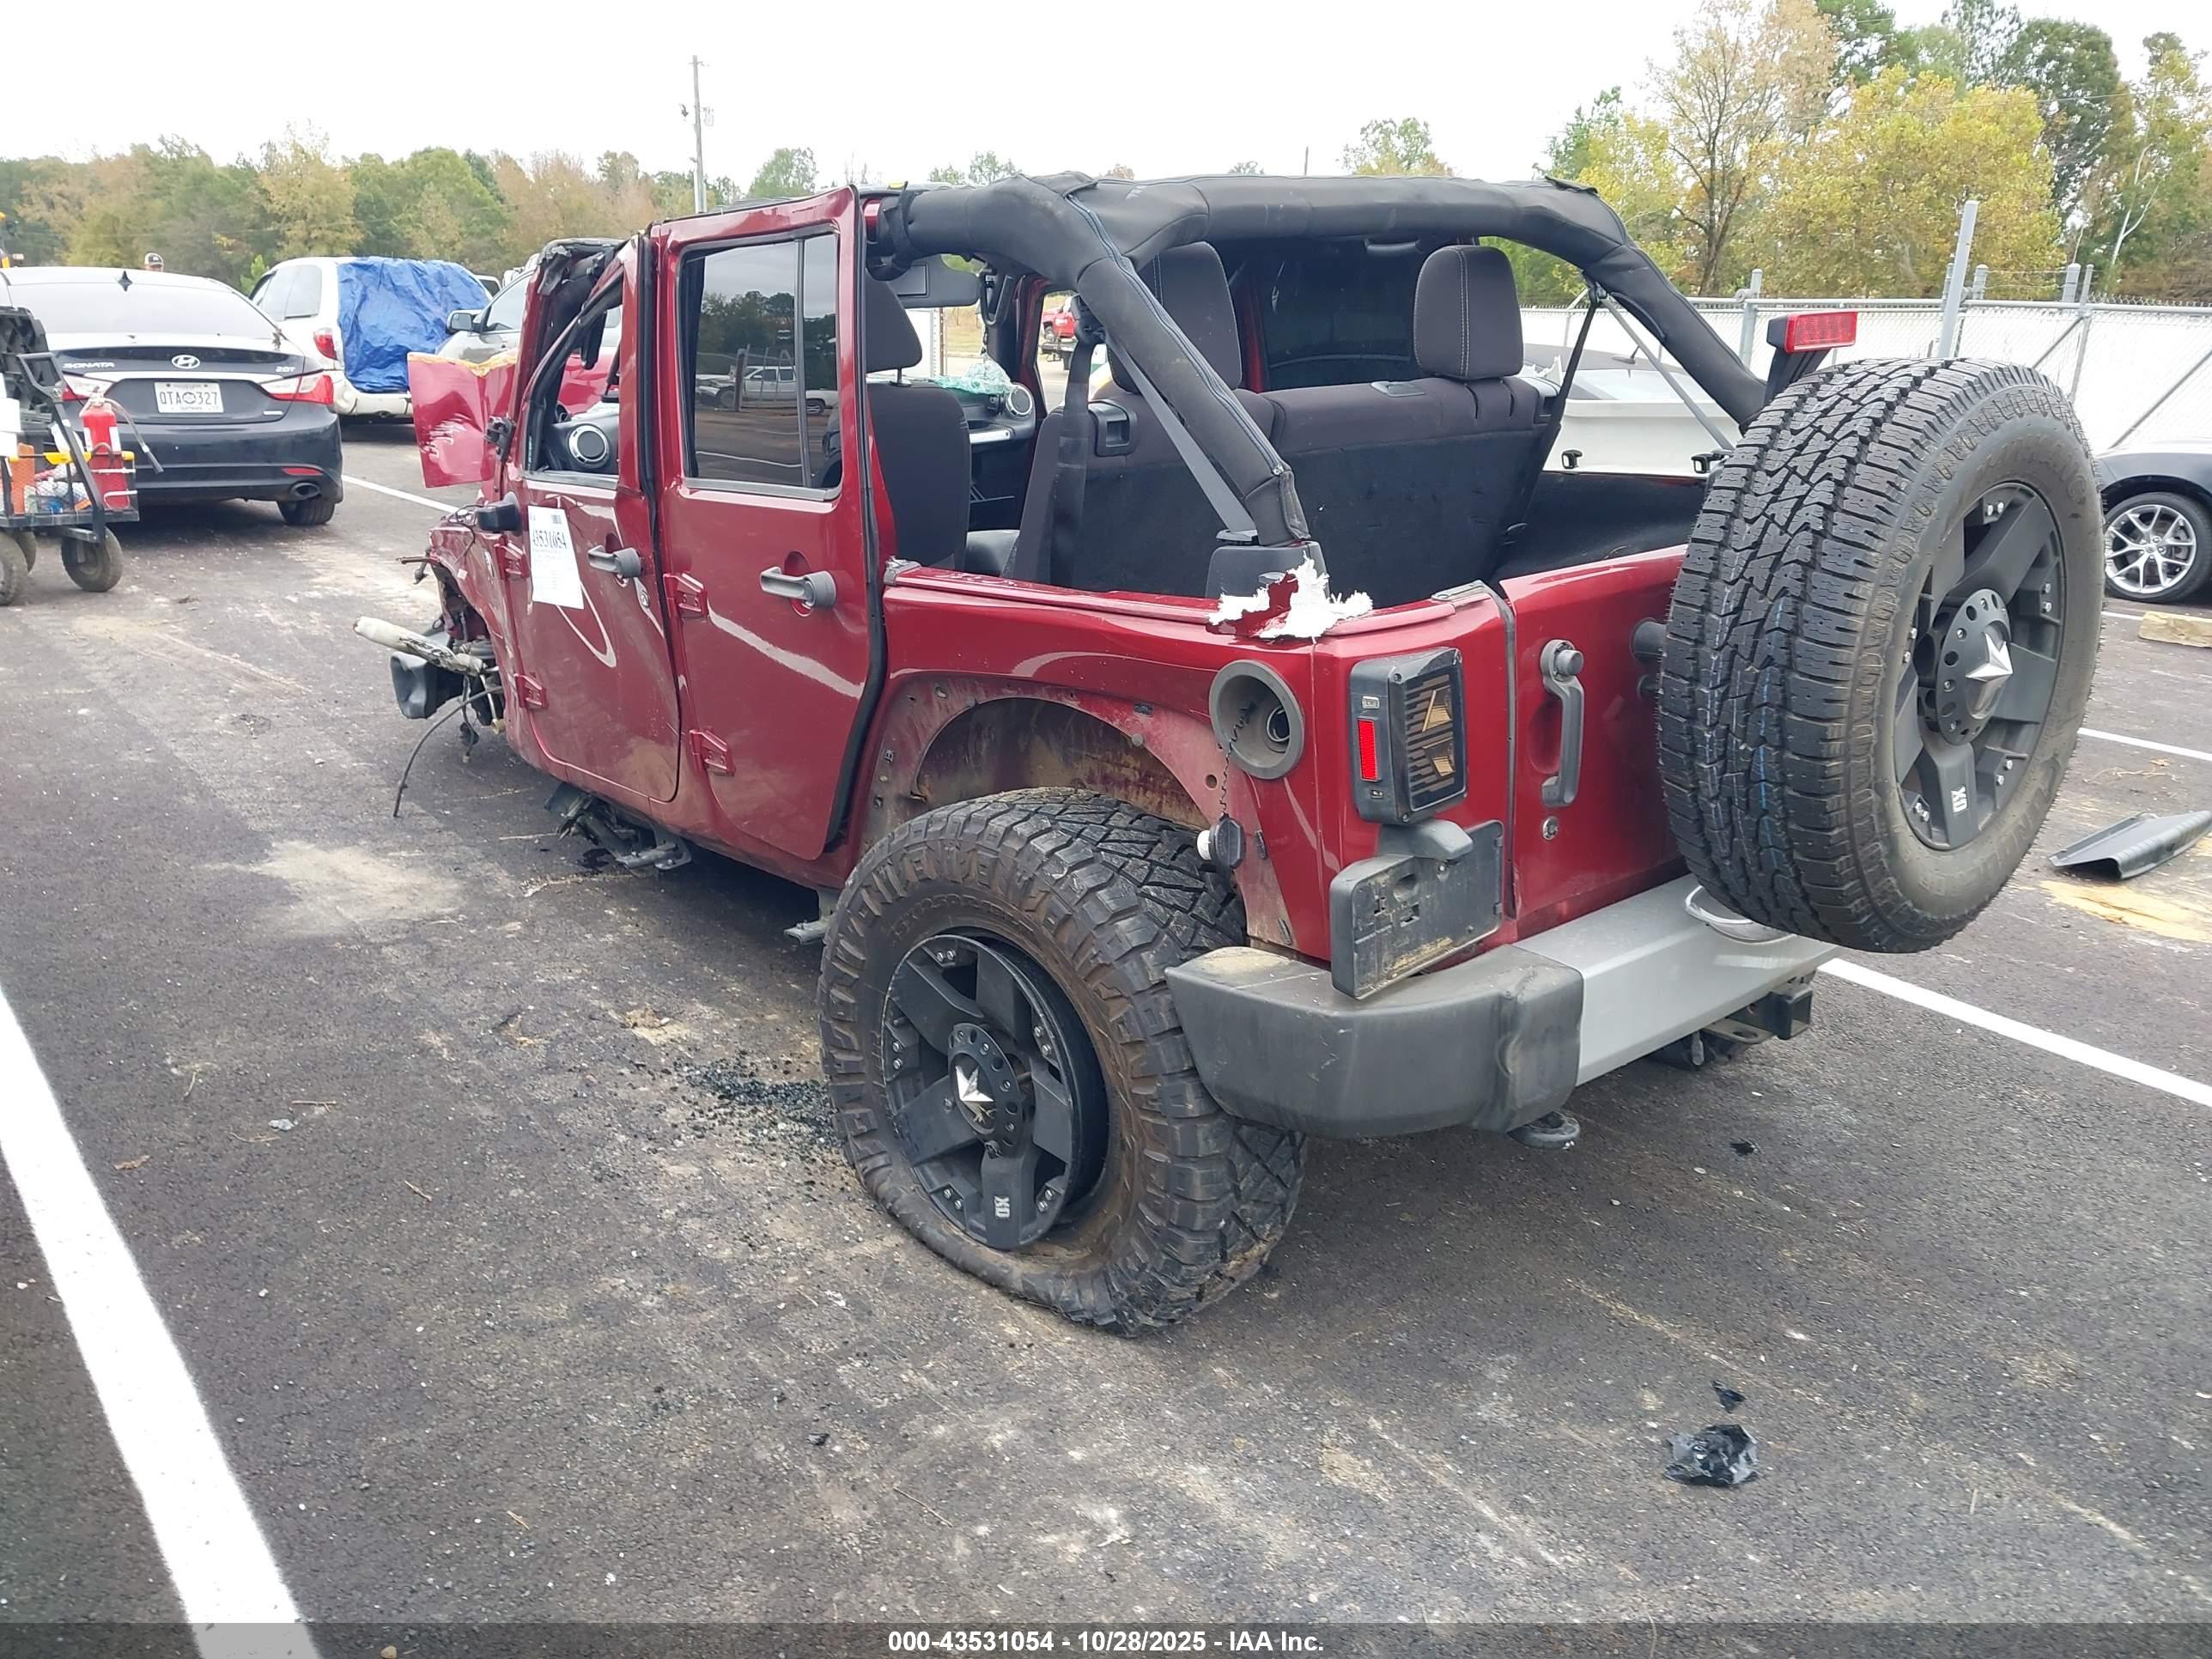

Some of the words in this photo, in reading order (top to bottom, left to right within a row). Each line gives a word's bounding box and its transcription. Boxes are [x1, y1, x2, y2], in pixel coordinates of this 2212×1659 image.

[197, 391, 217, 404] 327
[1950, 786, 1967, 812] XD
[994, 1194, 1011, 1218] XD
